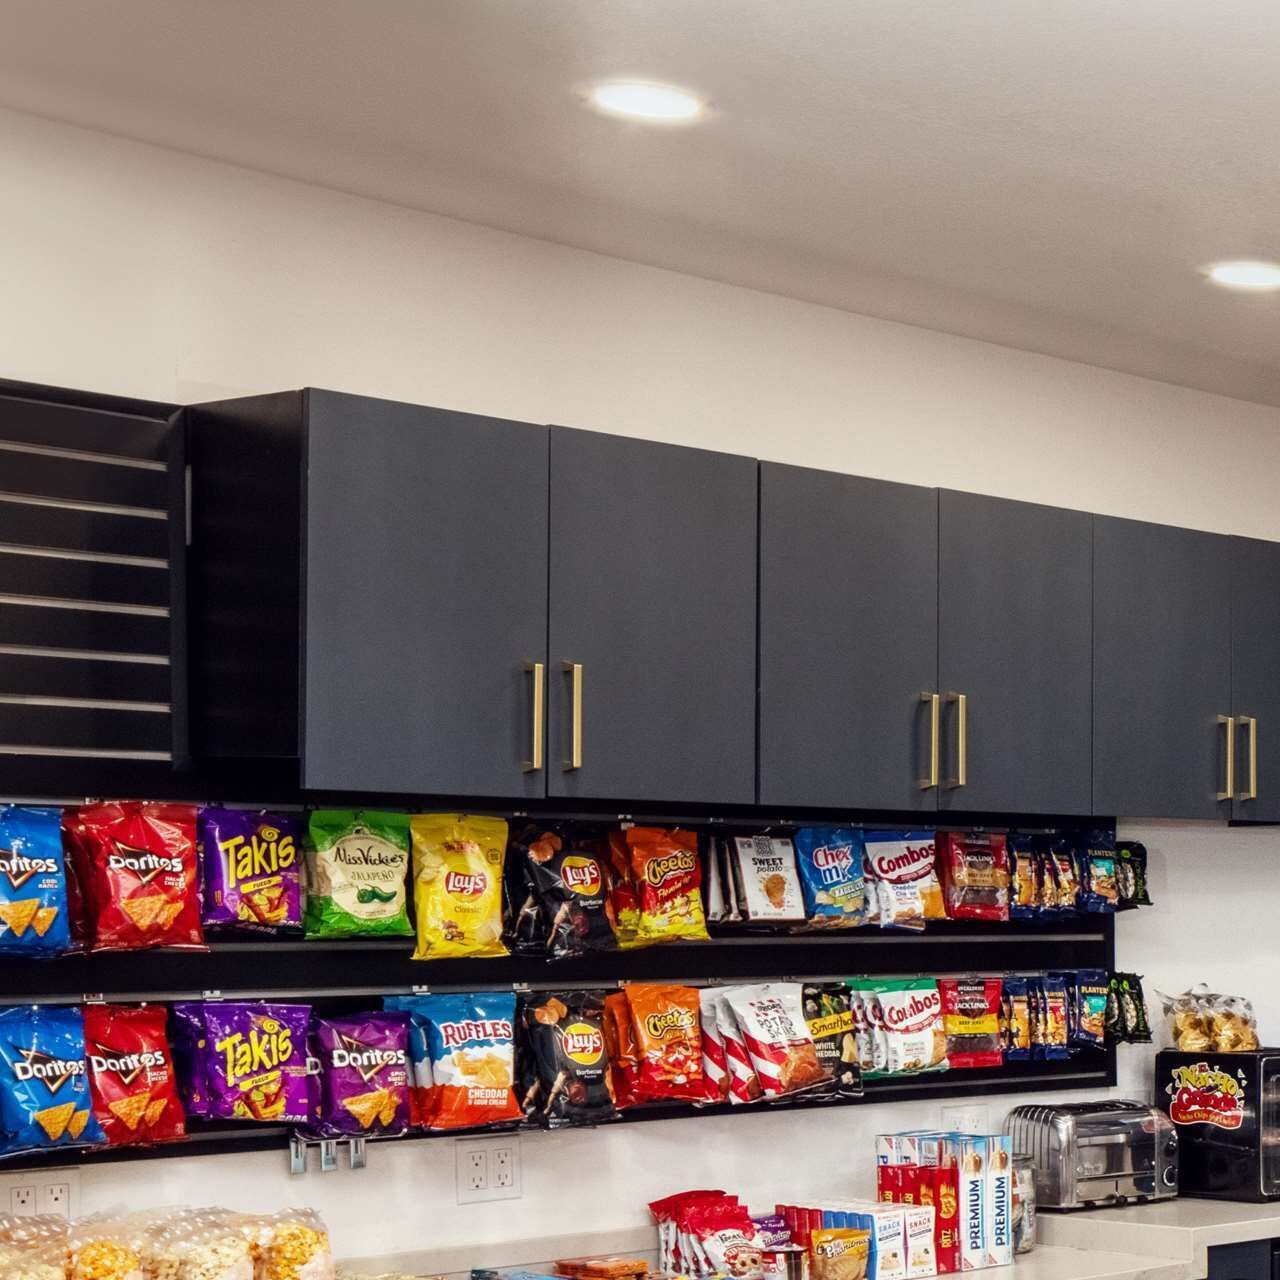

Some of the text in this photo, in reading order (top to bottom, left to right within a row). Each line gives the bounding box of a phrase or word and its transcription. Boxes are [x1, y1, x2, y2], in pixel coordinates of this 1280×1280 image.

[109, 854, 183, 873] Doritos
[220, 835, 296, 889] Takis
[752, 857, 783, 866] SWEET
[812, 846, 850, 867] Chex
[877, 843, 935, 875] Combos
[566, 864, 598, 888] Lay's
[648, 855, 695, 884] Cheetos
[448, 871, 485, 895] Lay's
[441, 1020, 513, 1047] RUFFLES
[647, 1010, 695, 1038] Cheetos
[567, 1033, 601, 1054] Lay's
[14, 1058, 85, 1080] Doritos
[90, 1051, 165, 1073] Doritos
[216, 1028, 293, 1087] Takis
[332, 1049, 405, 1068] Doritos
[468, 1089, 508, 1099] CHEDDAR
[970, 1179, 980, 1250] PREMIUM
[996, 1176, 1006, 1246] PREMIUM
